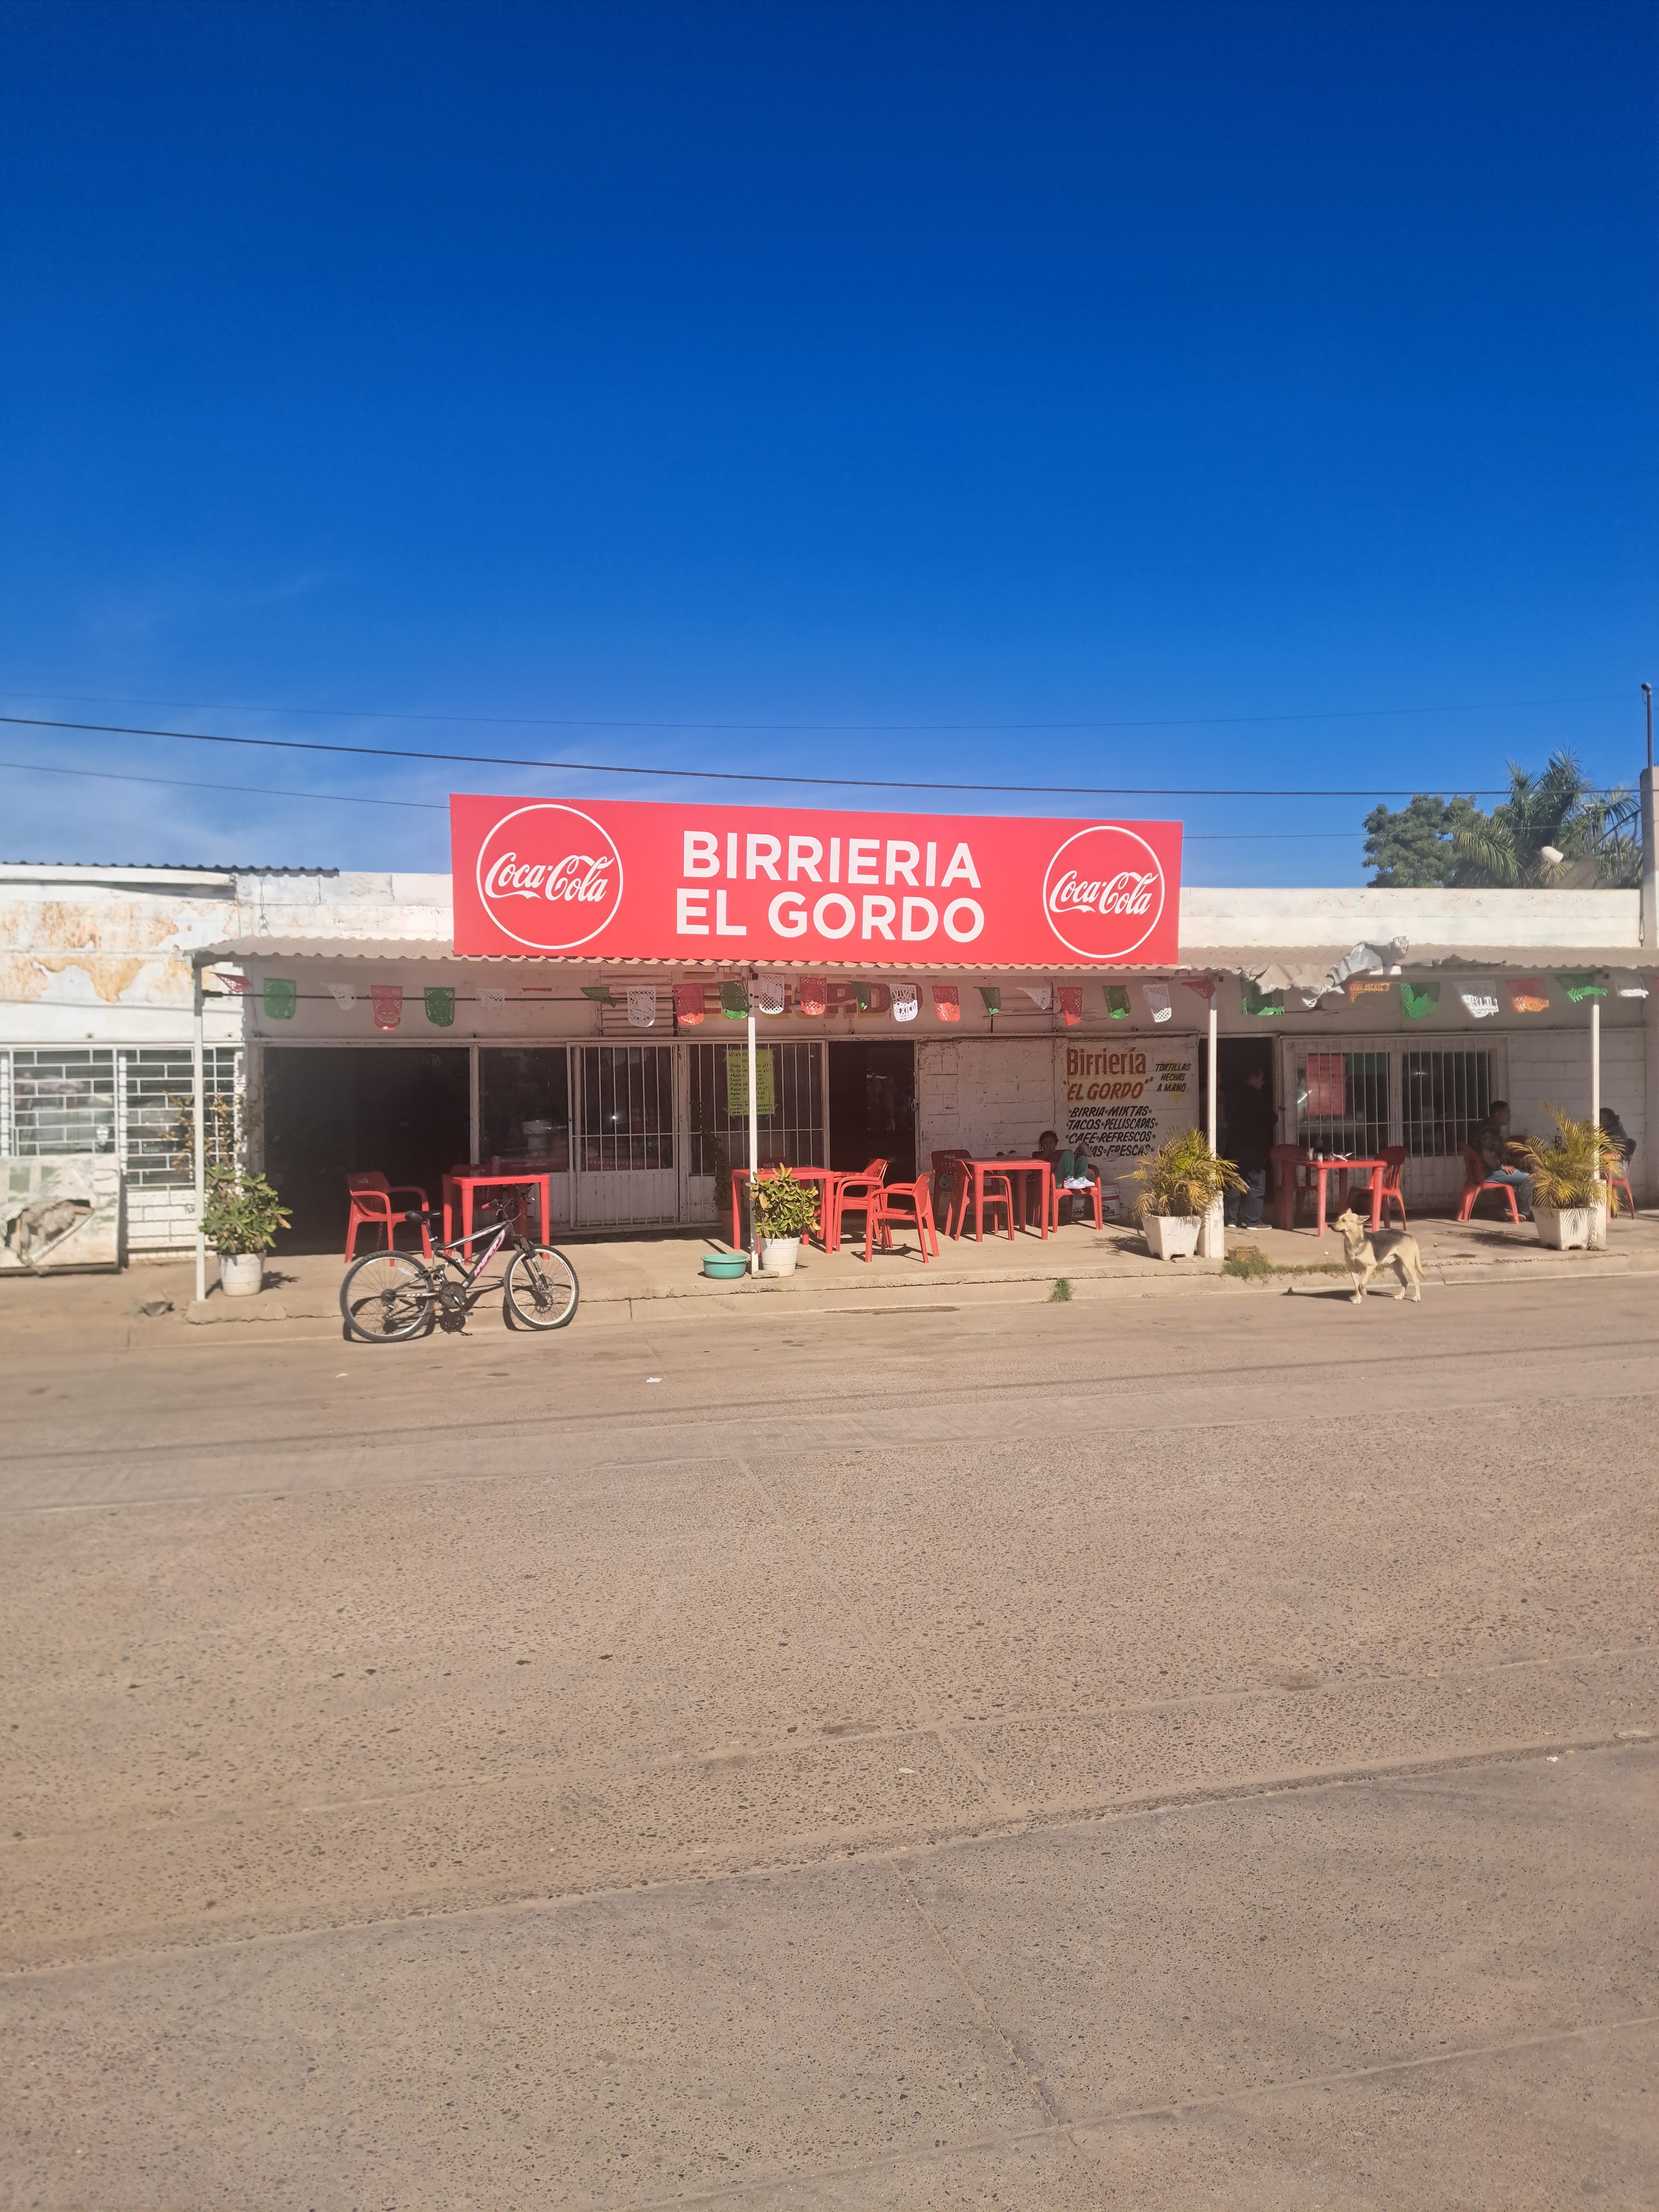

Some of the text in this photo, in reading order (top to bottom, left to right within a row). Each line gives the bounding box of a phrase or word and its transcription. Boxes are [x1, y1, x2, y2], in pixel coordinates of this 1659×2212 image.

[684, 831, 981, 888] BIRRIERIA
[485, 852, 614, 902] Coca-Cola
[1050, 870, 1159, 914] Coca-Cola
[677, 888, 984, 942] EL GORDO
[892, 990, 912, 999] VIVA
[894, 1002, 916, 1015] MEXICO
[1067, 1047, 1146, 1075] Birriería
[1156, 1063, 1191, 1071] TORTILLAS
[1161, 1073, 1186, 1081] HECHAS
[1157, 1083, 1187, 1092] A MANO
[1070, 1106, 1149, 1117] BIRRIA MIXTAS
[1069, 1118, 1156, 1130] TACOS PELLISCADAS
[1069, 1131, 1152, 1144] CAFE REFRESCOS
